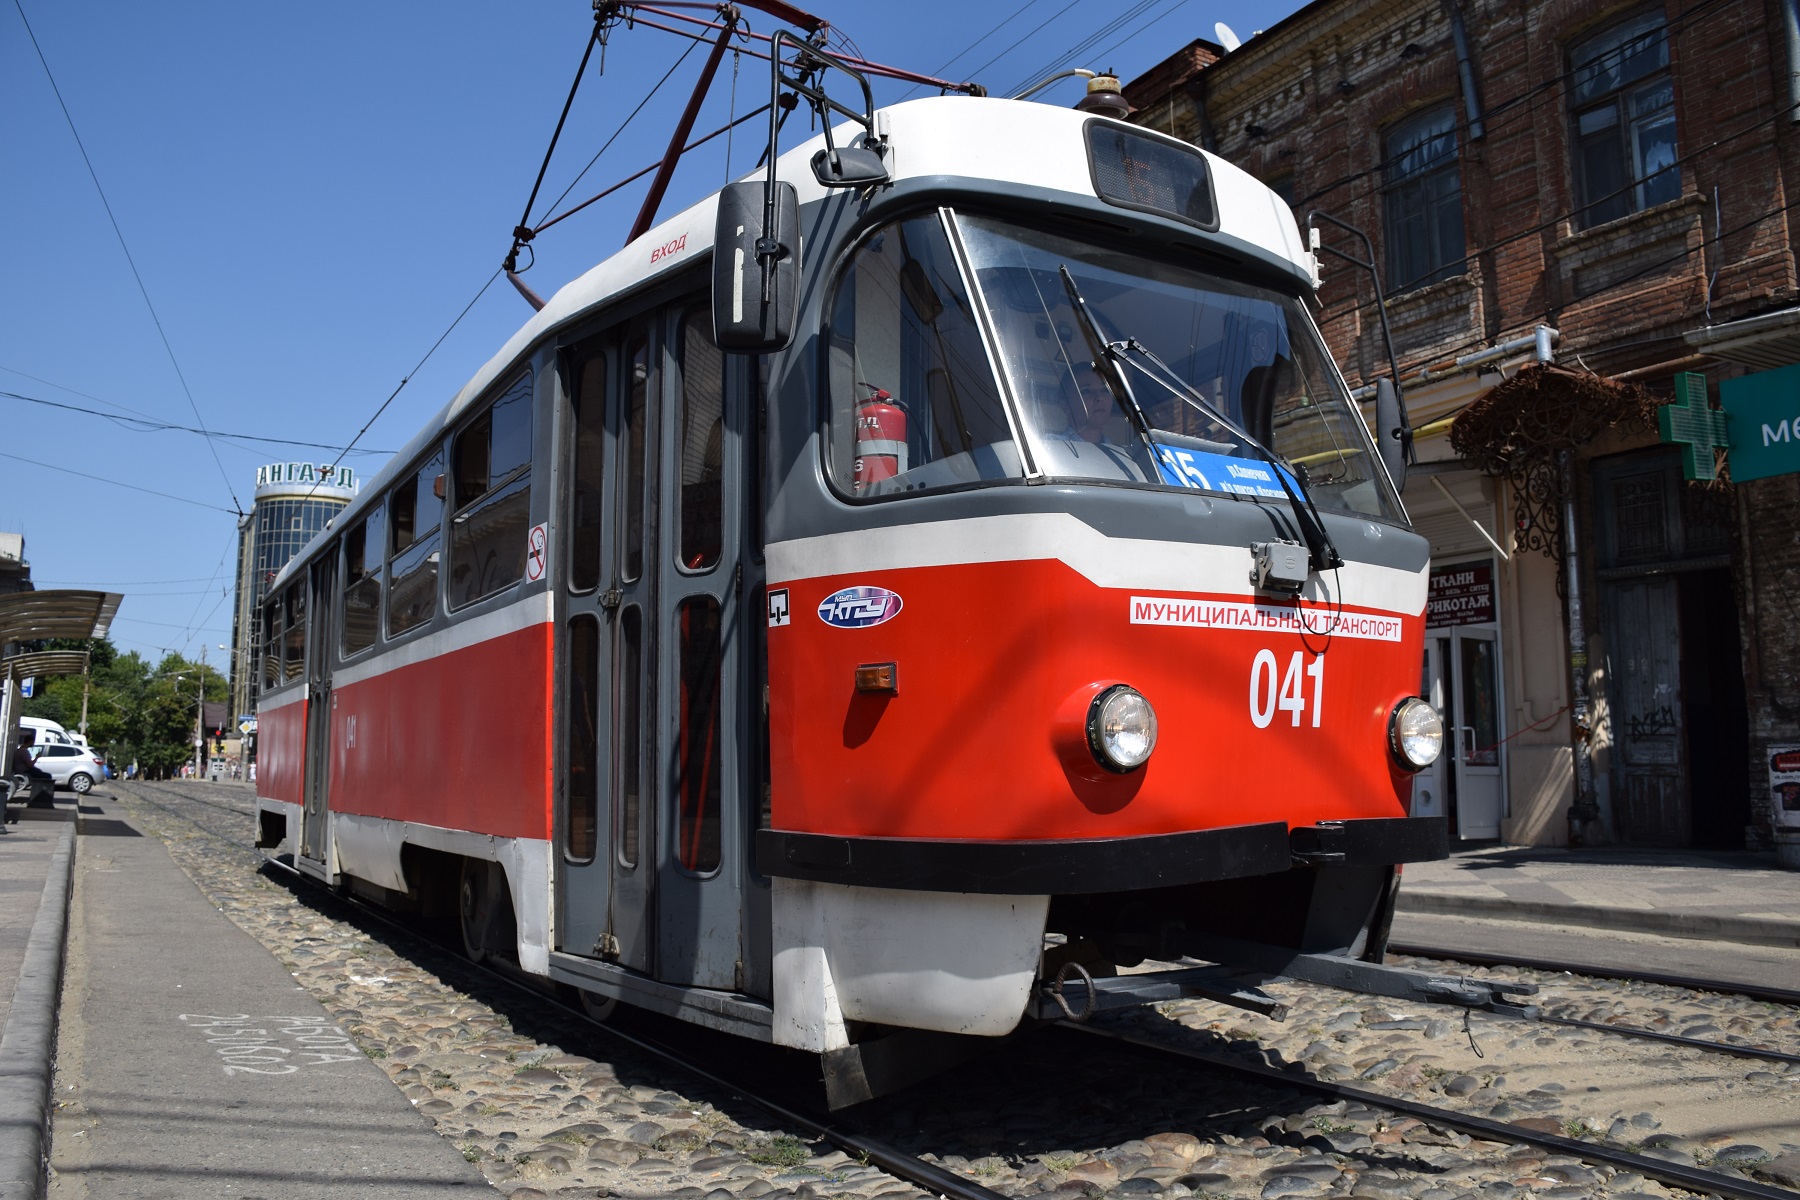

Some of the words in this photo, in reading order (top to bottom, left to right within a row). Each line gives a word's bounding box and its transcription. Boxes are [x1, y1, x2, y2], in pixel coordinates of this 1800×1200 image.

[1122, 157, 1155, 206] 15
[650, 234, 687, 264] ВХОД
[1161, 449, 1212, 490] 15
[1431, 571, 1475, 588] ТКАНИ
[1135, 602, 1318, 632] МУНИЦИПАЛЬНЫЙ
[1323, 615, 1399, 638] ТРАНСПОРТ
[1426, 595, 1490, 614] РИКОТАЖ
[1249, 648, 1325, 729] 041
